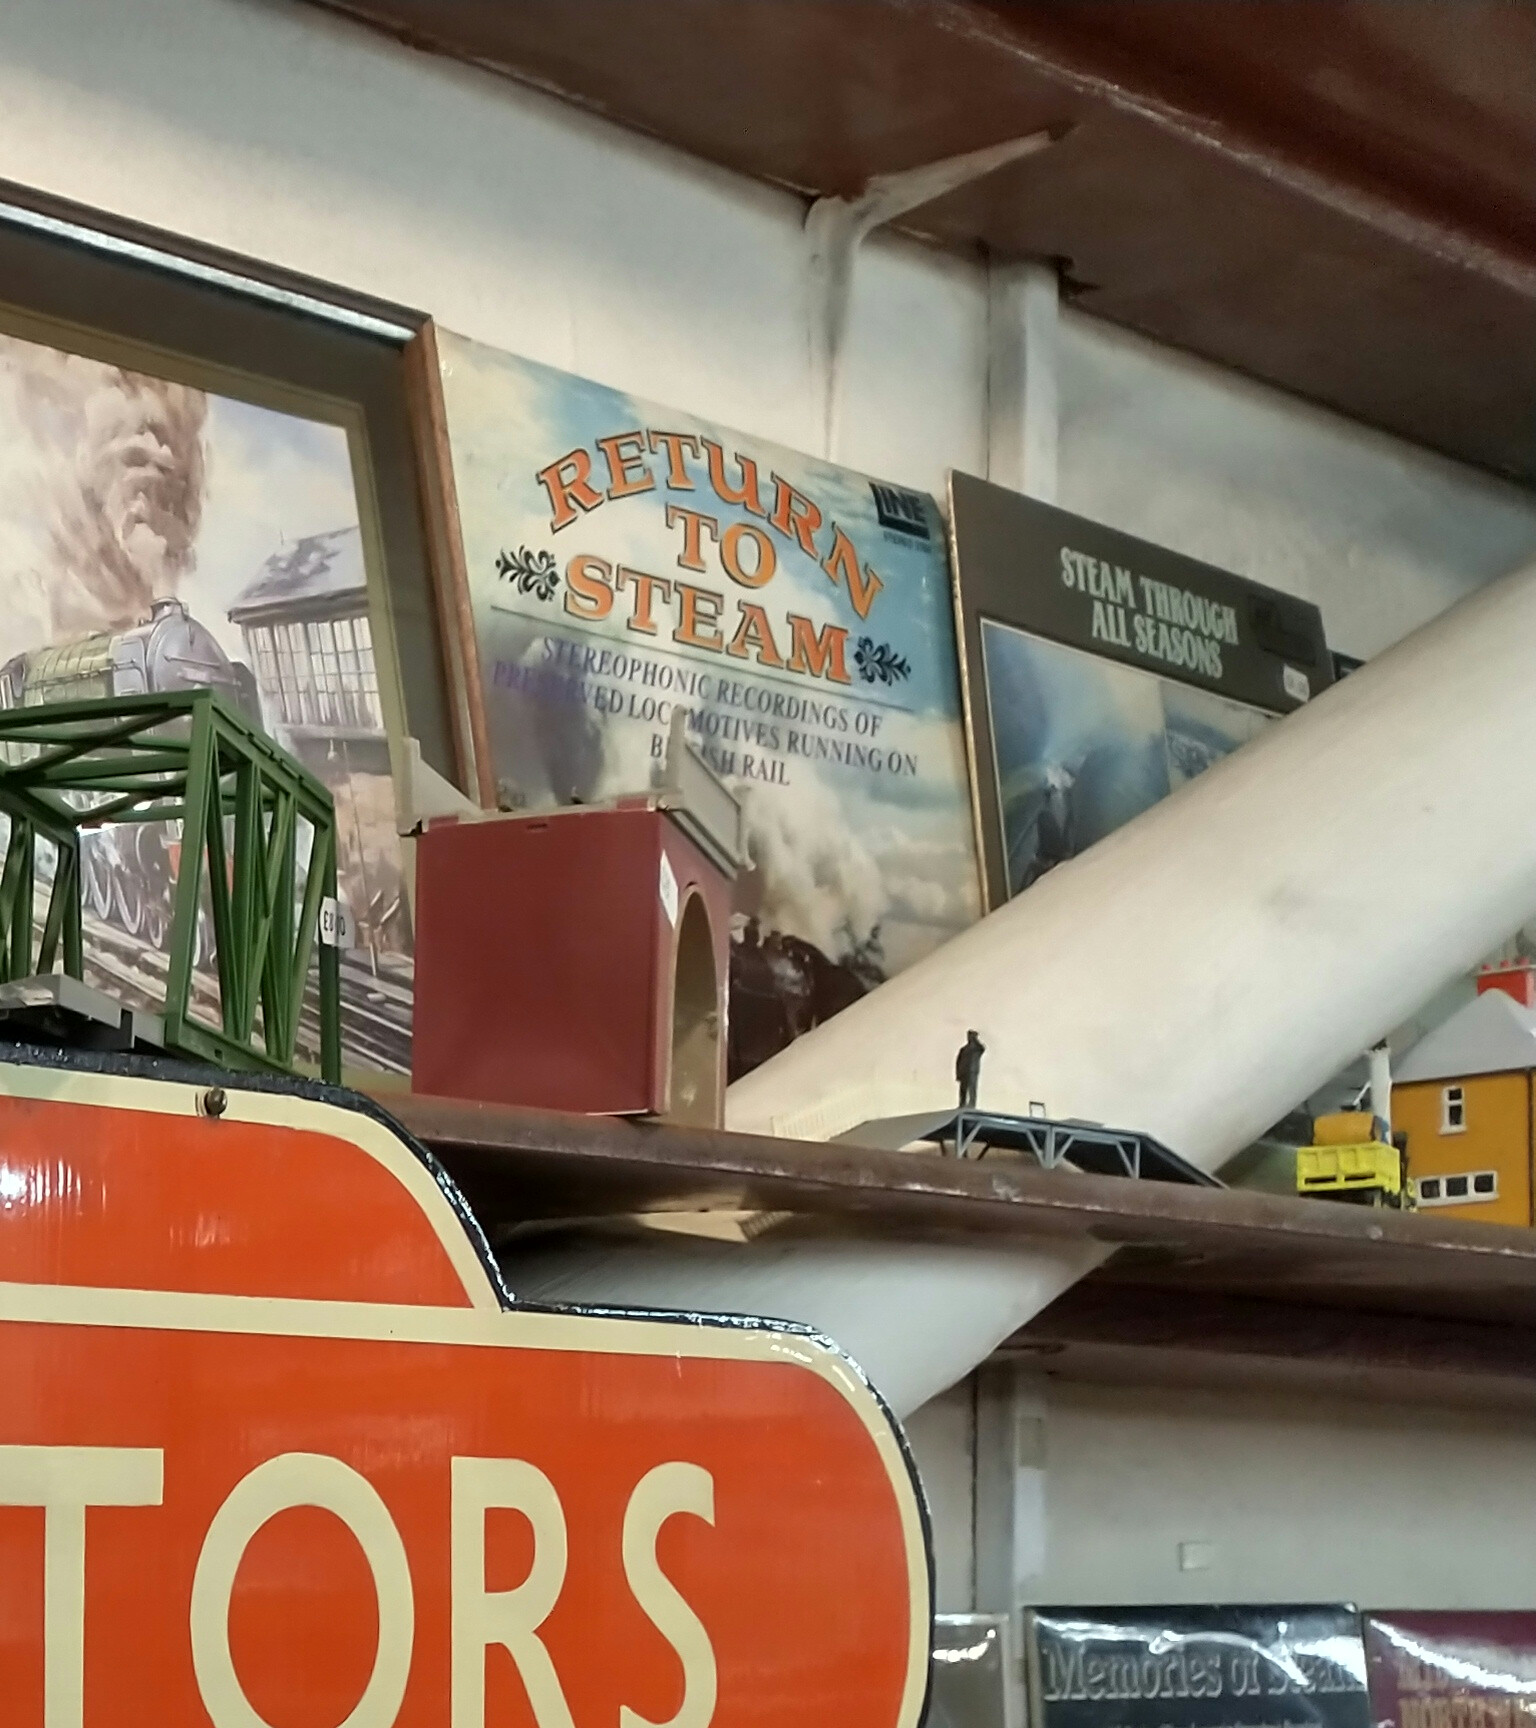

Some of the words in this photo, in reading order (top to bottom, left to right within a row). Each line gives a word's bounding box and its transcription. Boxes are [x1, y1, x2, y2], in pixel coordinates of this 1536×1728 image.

[537, 429, 884, 619] RETURN
[667, 503, 777, 589] TO
[564, 554, 851, 684] STEAM
[1060, 547, 1136, 609] STEAM
[1139, 576, 1239, 645] THROUGH
[1092, 601, 1131, 647] ALL
[1133, 613, 1222, 679] SEASONS
[542, 636, 711, 698] STEREOPHONIC
[717, 680, 849, 732] RECORDINGS
[854, 712, 882, 738] OF
[629, 691, 780, 750] LOCMOTIVES
[787, 730, 882, 773] RUNNING
[887, 752, 918, 777] ON
[743, 754, 791, 786] RAIL
